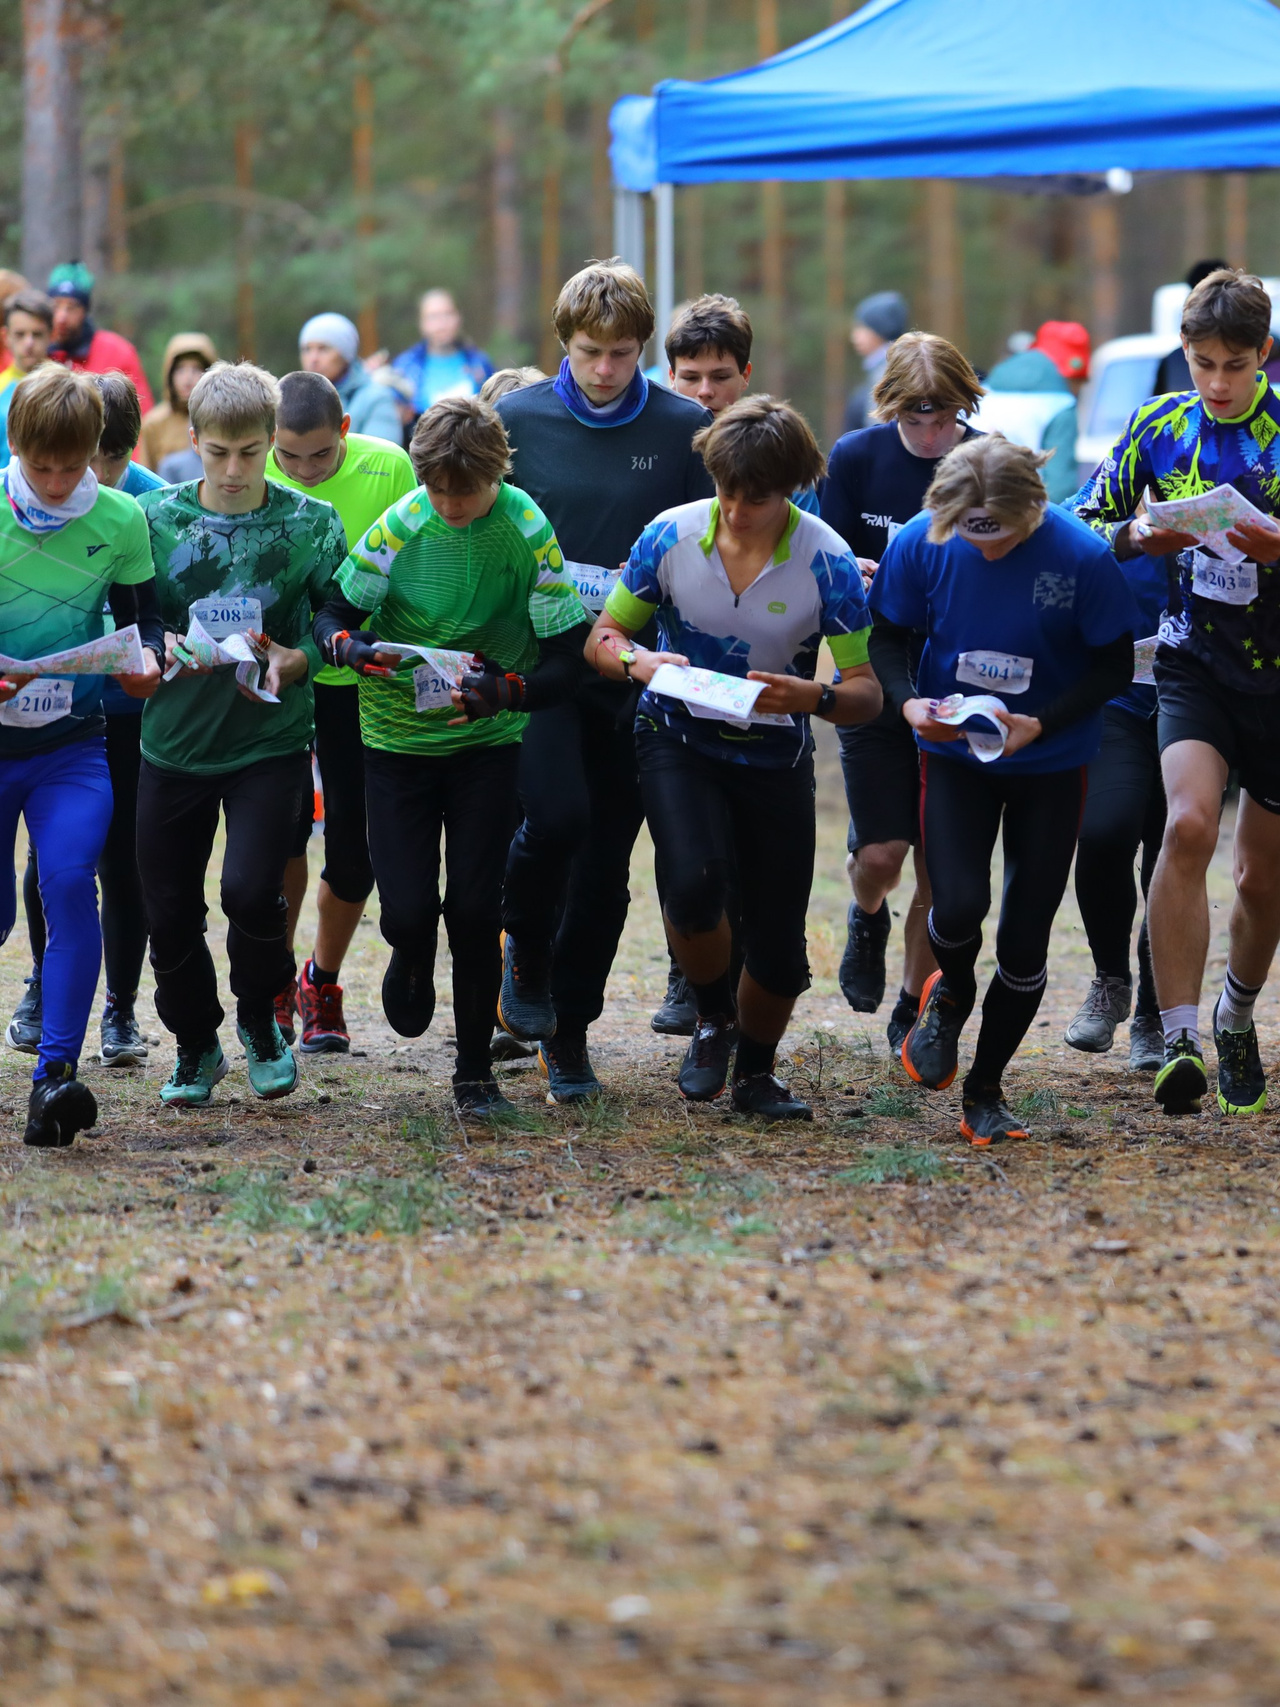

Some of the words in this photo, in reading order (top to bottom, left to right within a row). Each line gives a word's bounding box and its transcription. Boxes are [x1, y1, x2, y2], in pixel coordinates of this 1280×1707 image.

[630, 454, 659, 470] 361°
[572, 579, 600, 598] 06
[1208, 571, 1237, 591] 203
[210, 608, 242, 623] 208
[978, 662, 1010, 681] 204
[430, 677, 452, 694] 20
[21, 695, 52, 713] 210
